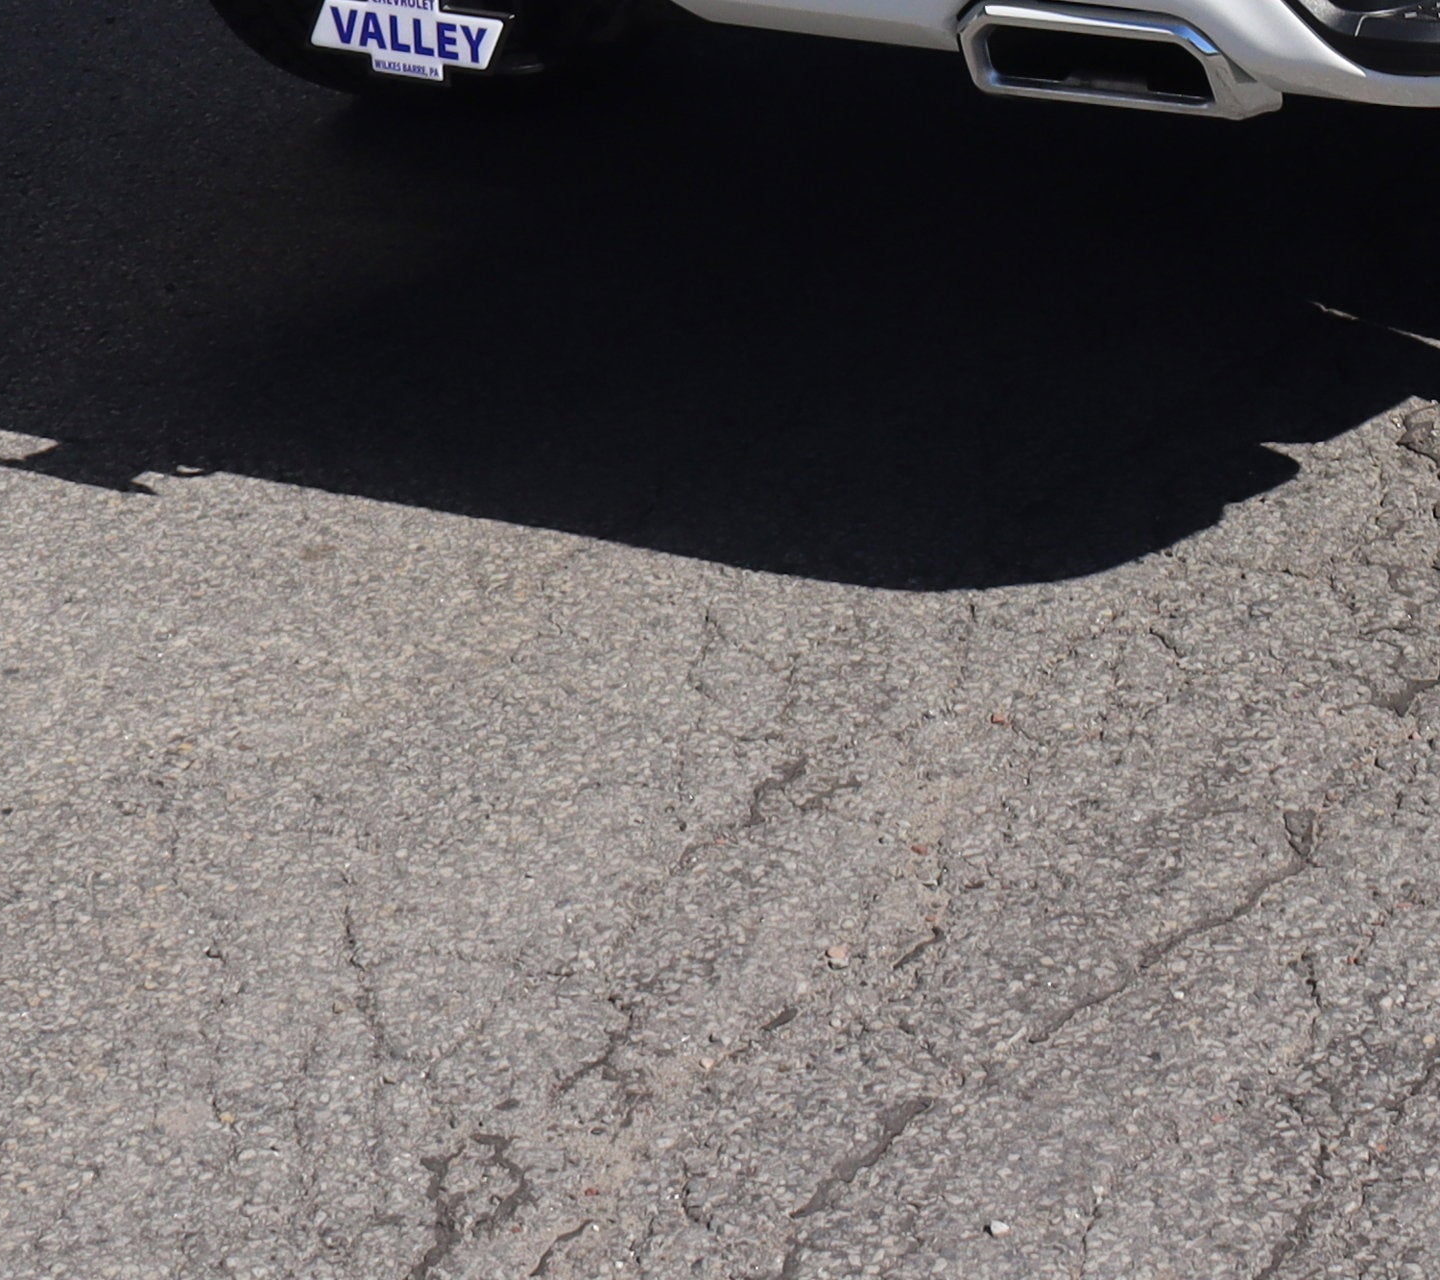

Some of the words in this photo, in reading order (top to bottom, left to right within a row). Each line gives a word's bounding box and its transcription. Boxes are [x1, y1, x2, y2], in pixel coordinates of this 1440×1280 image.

[329, 6, 487, 64] VALLEY
[374, 59, 401, 72] WILKES
[402, 63, 429, 77] BARRE,
[429, 67, 439, 78] PA
